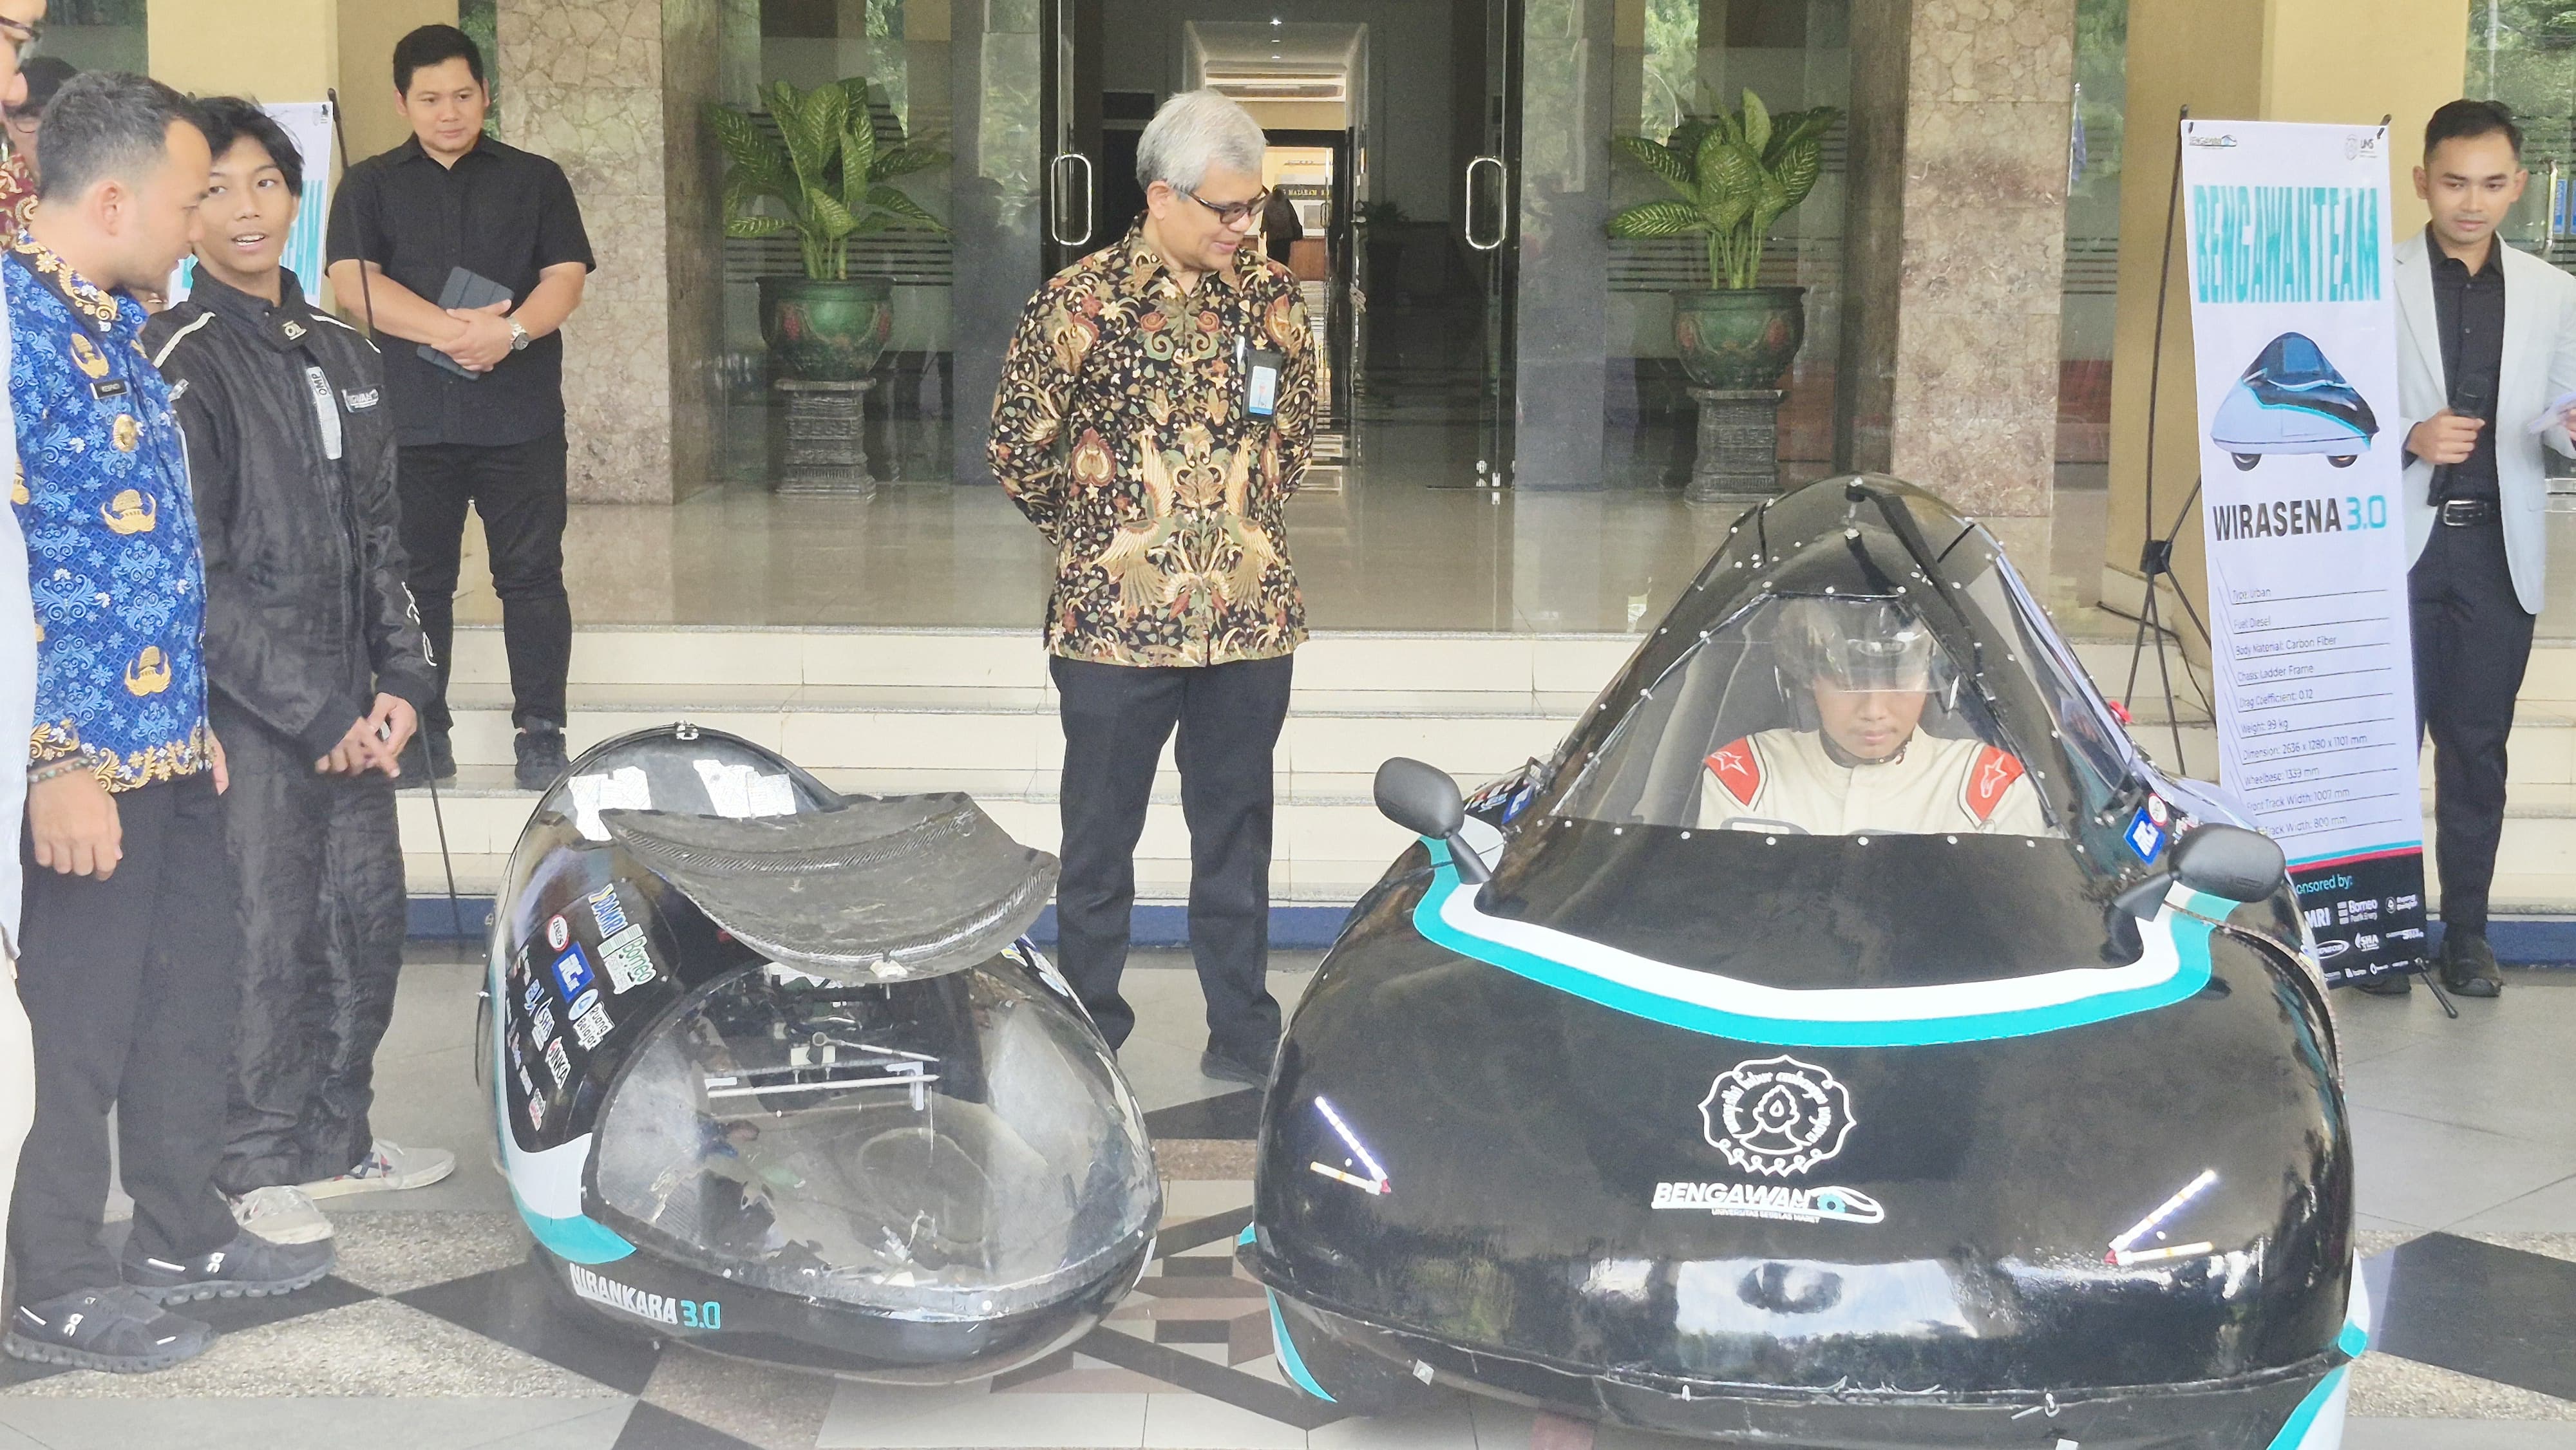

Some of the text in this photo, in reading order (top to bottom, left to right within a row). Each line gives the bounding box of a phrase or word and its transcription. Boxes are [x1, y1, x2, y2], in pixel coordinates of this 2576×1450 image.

[311, 373, 327, 395] OMP
[2213, 494, 2387, 541] WIRASENA 3.0
[2236, 645, 2251, 656] Body
[2286, 638, 2315, 650] Carbon
[2317, 636, 2337, 646] Fiber
[2260, 667, 2286, 679] Ladder
[2289, 665, 2314, 675] Frame
[2279, 719, 2289, 731] kg
[2351, 735, 2367, 744] mm
[2304, 767, 2320, 777] mm
[2266, 797, 2285, 808] Track
[2314, 789, 2333, 801] 1007
[2334, 789, 2350, 798] mm
[2313, 816, 2330, 828] 800
[2331, 816, 2347, 825] mm
[2297, 876, 2336, 894] onsored
[592, 893, 627, 936] DAMRI
[621, 937, 655, 984] Borneo
[588, 1006, 610, 1035] Ruang
[575, 1017, 598, 1050] Belajar
[1653, 1182, 1809, 1208] BENGAWAN
[569, 1263, 721, 1330] NIRANKARA 3.0
